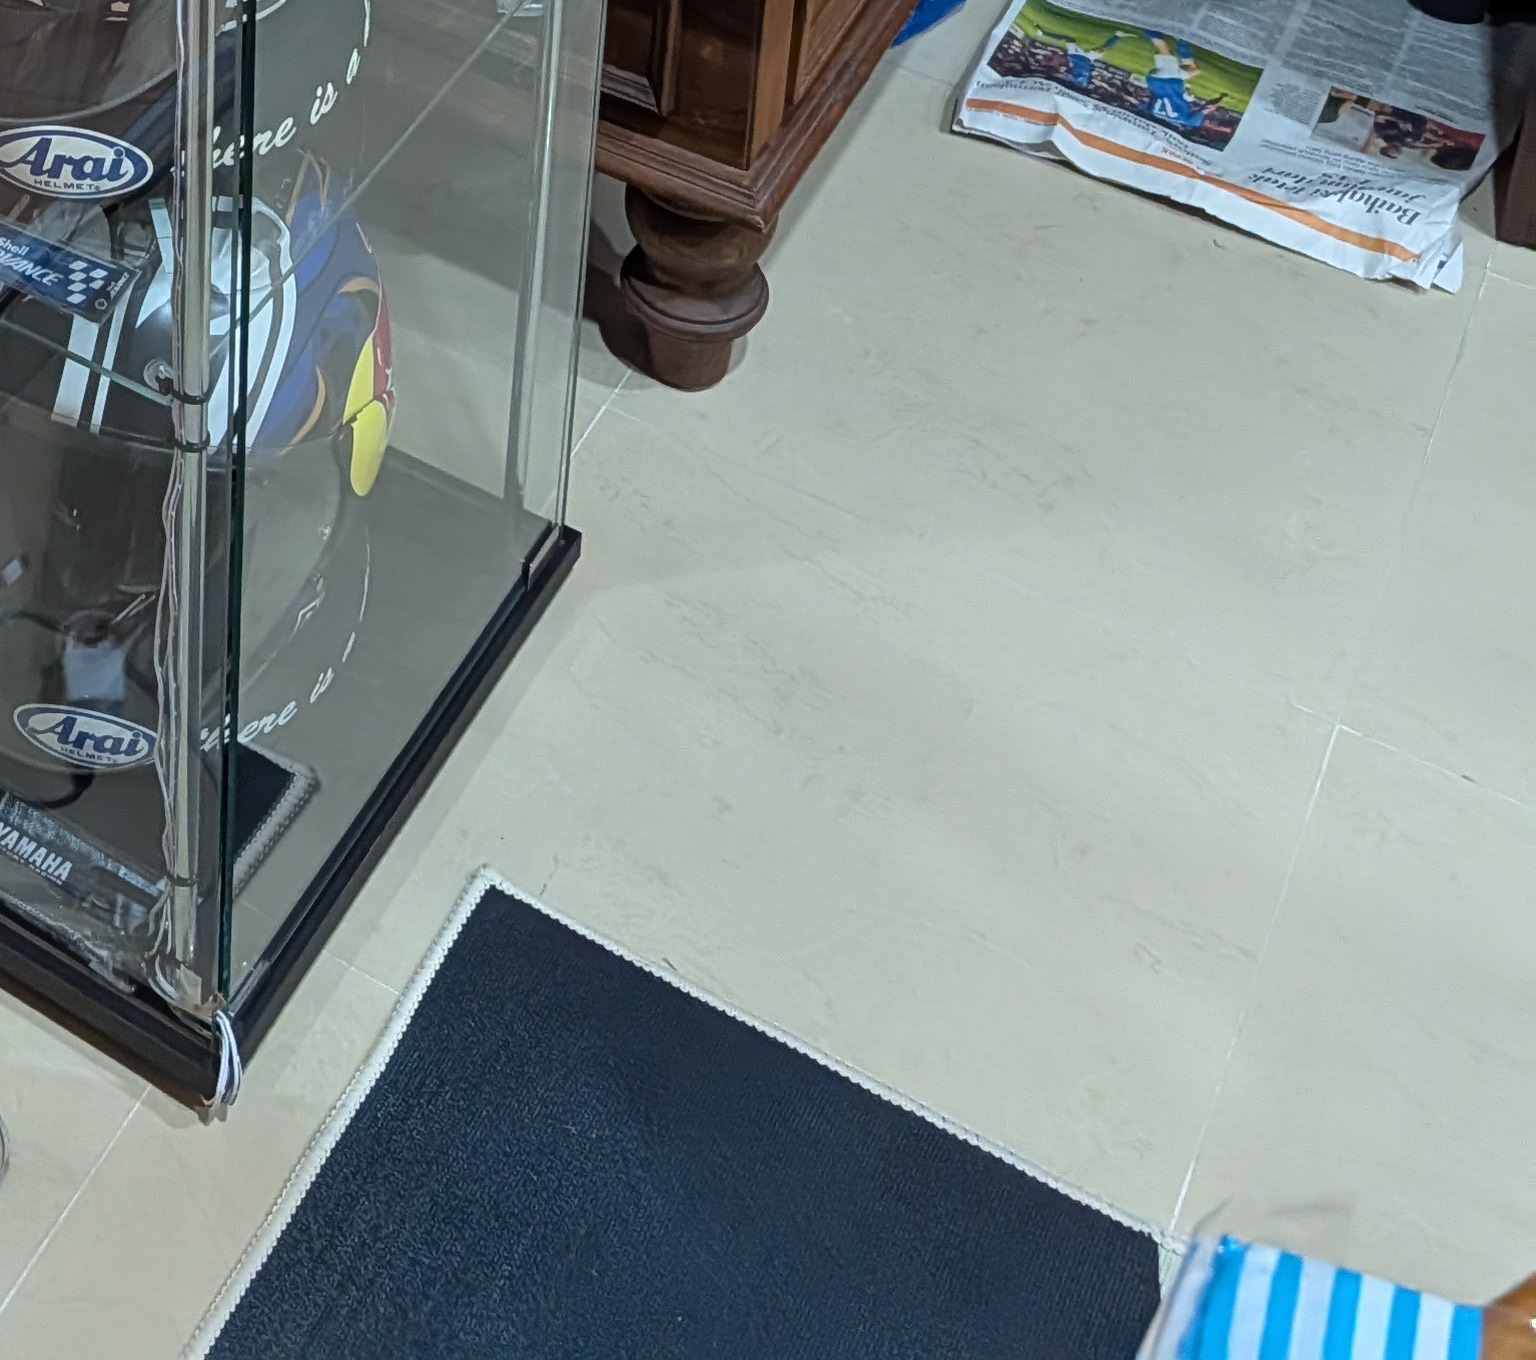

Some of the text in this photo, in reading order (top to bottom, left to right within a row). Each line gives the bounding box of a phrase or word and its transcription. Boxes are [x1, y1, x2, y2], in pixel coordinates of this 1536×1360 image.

[310, 82, 338, 125] is
[34, 178, 94, 192] HELMET
[25, 715, 145, 758] Arai
